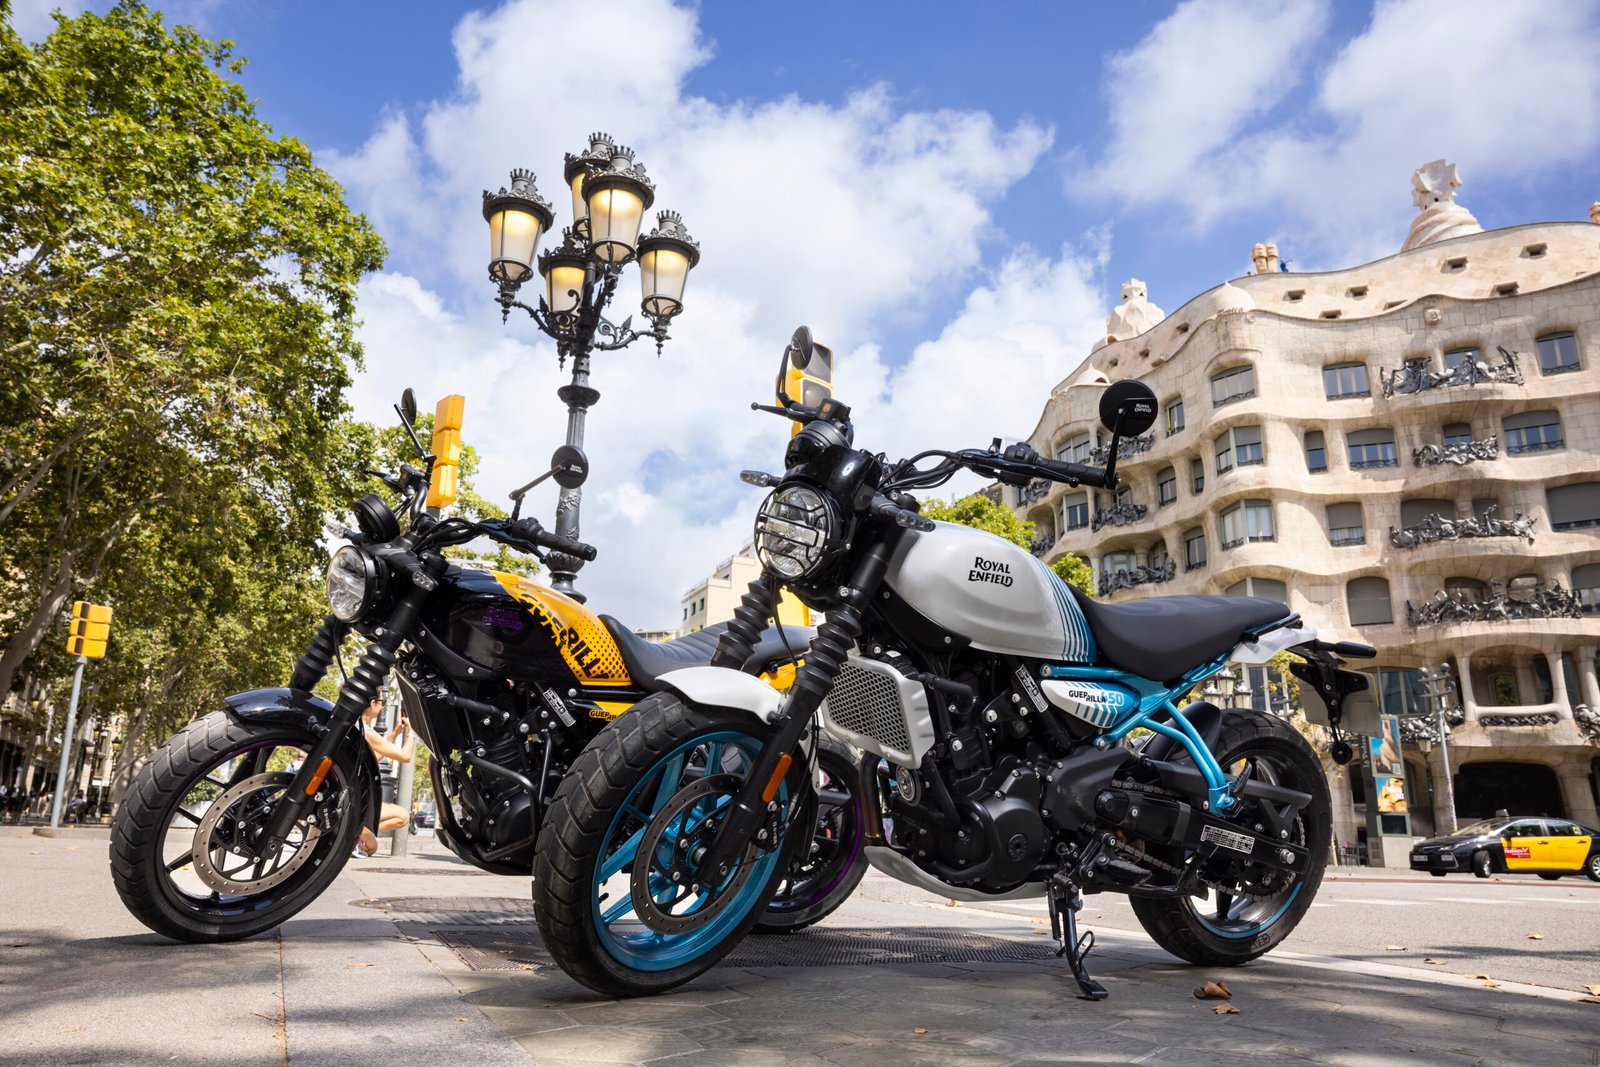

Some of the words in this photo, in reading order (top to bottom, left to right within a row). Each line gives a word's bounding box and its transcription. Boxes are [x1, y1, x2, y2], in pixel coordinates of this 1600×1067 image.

[974, 556, 1011, 574] ROYAL
[968, 569, 1014, 588] ENFIELD
[1068, 690, 1108, 704] GUERRILLA
